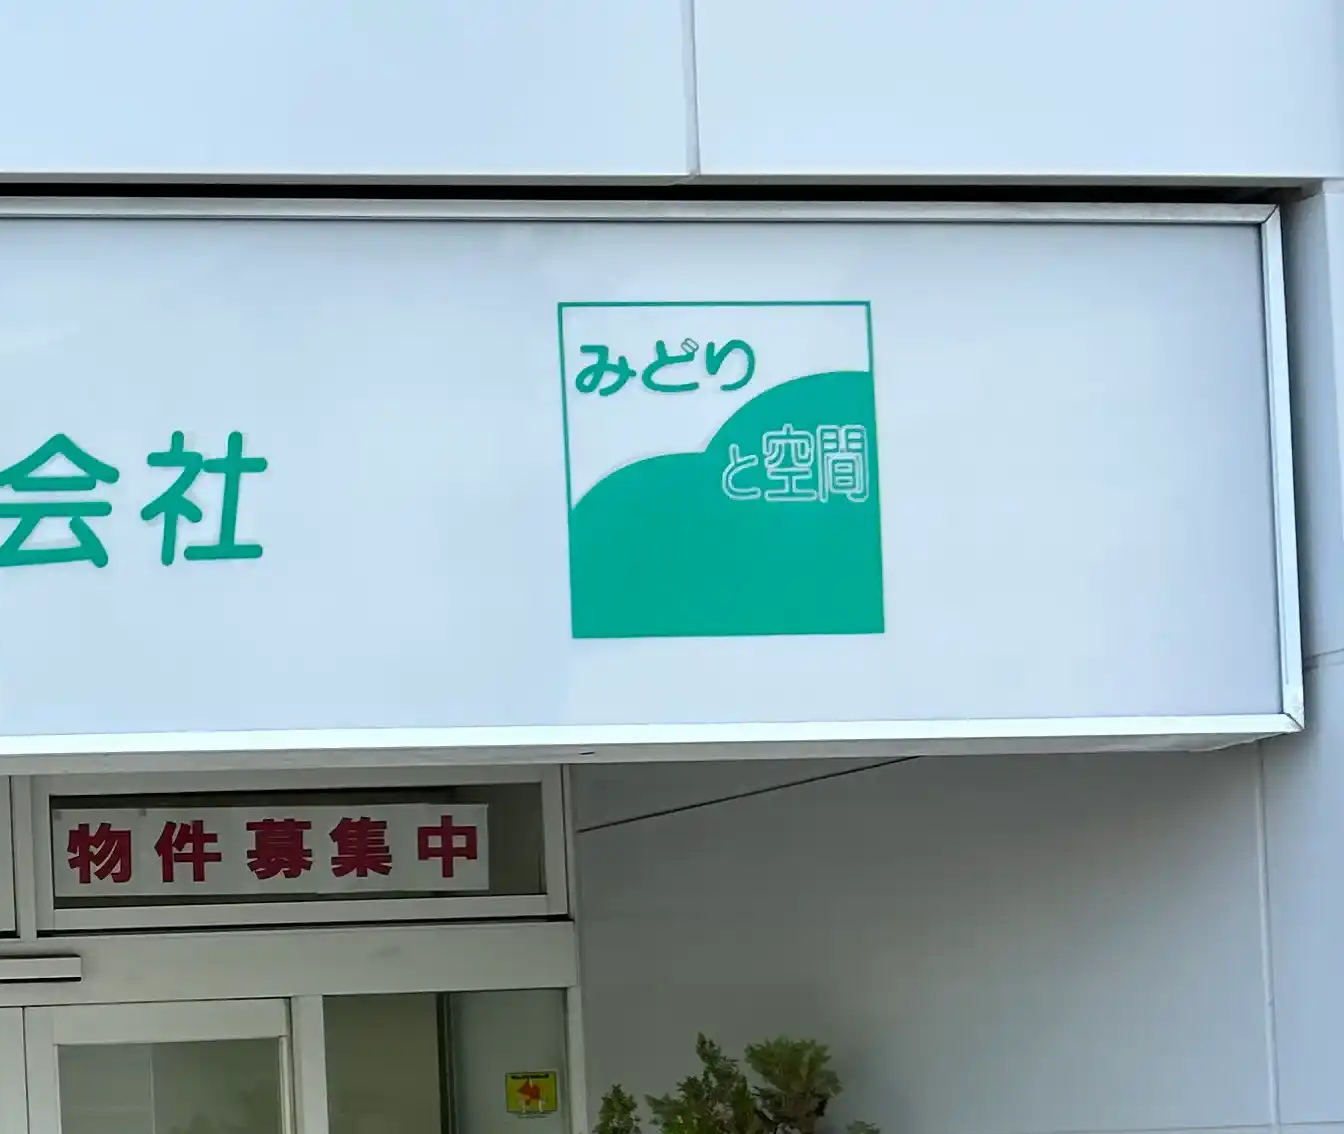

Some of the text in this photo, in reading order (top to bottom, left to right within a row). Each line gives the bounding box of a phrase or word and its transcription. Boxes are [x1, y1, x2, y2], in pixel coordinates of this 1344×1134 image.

[575, 338, 755, 396] みどり
[722, 423, 869, 502] と空間
[67, 814, 478, 884] 物件募集中
